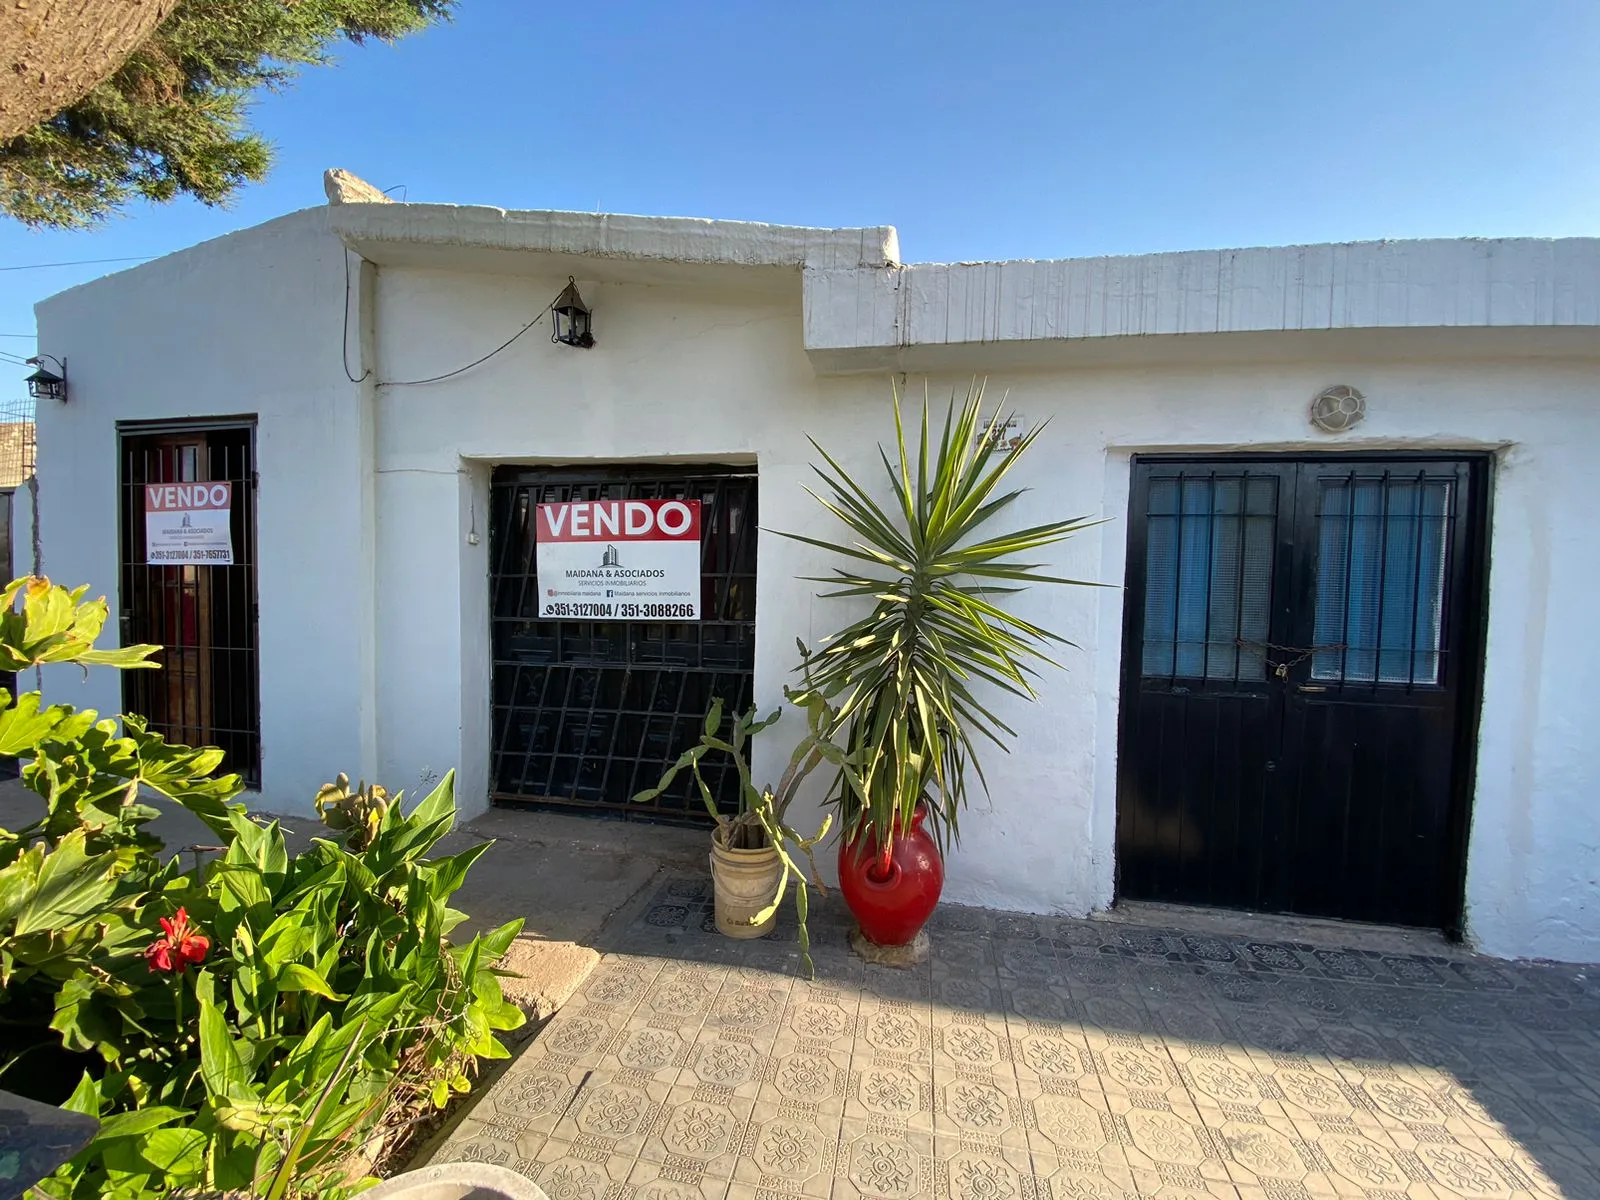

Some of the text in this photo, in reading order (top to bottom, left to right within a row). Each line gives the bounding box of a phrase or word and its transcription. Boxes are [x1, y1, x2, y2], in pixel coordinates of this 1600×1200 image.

[149, 485, 228, 508] VENDO
[544, 501, 692, 536] VENDO
[565, 569, 665, 578] MAIDANA & ASOCIADOS
[555, 603, 694, 617] 351-3127004 / 351-3088266
